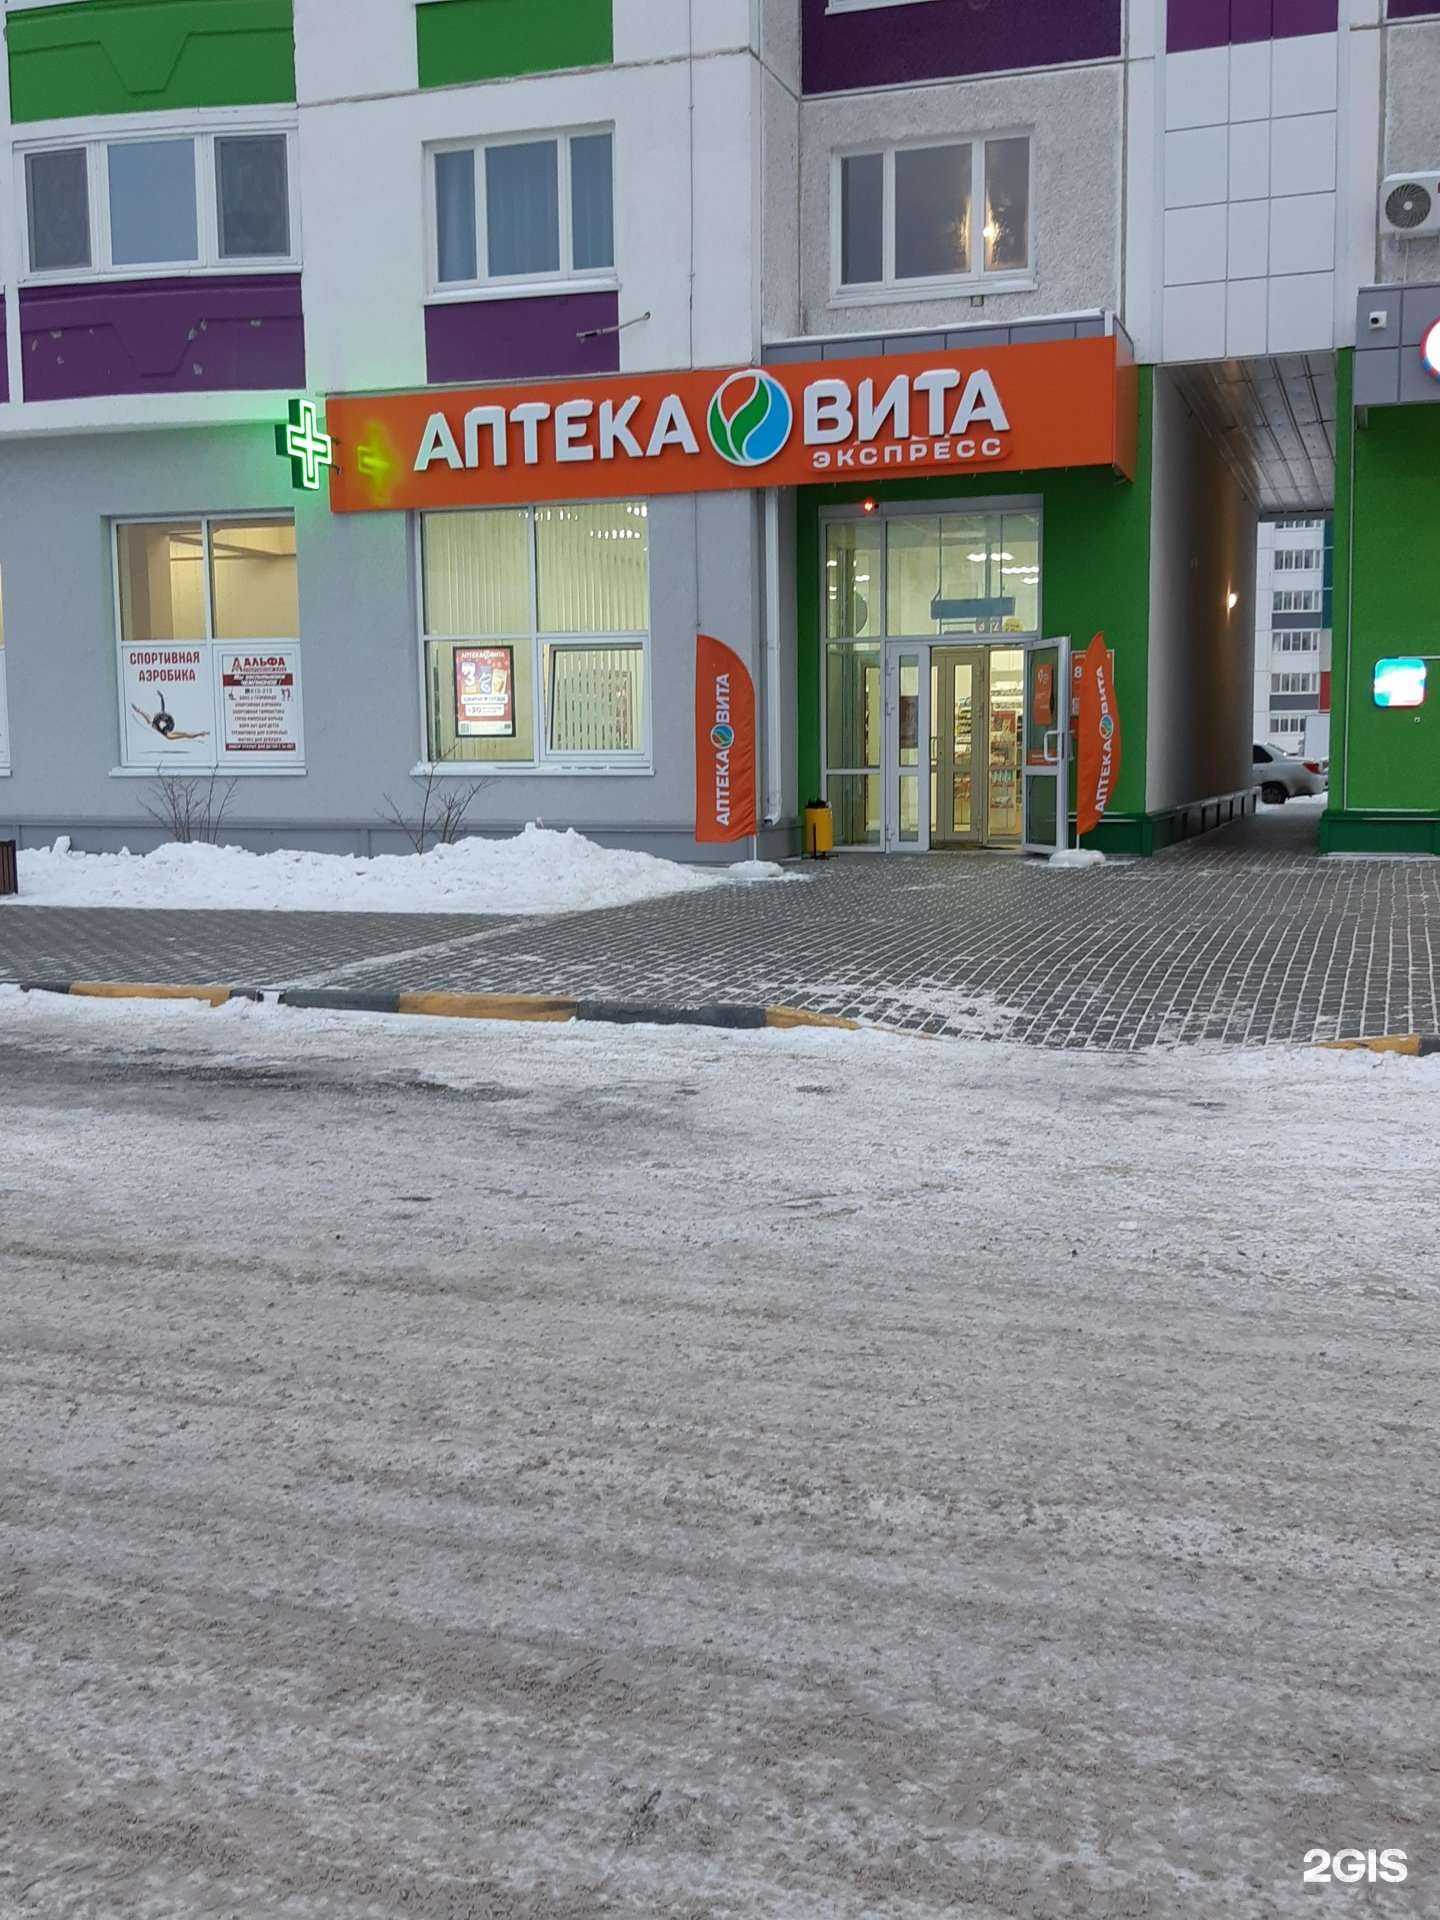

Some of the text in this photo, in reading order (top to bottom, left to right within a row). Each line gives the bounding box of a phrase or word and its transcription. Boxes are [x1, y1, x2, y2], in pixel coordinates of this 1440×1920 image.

[413, 368, 1011, 472] АПТЕКА ВИТА
[812, 437, 1002, 468] ЭКСПРЕСС
[129, 651, 201, 666] СПОРТИВНАЯ
[244, 656, 286, 667] АЛЬФА
[138, 669, 196, 683] АЭРОБИКА
[716, 673, 730, 826] АПТЕКА ВИТА
[1094, 740, 1113, 812] АПТЕКА
